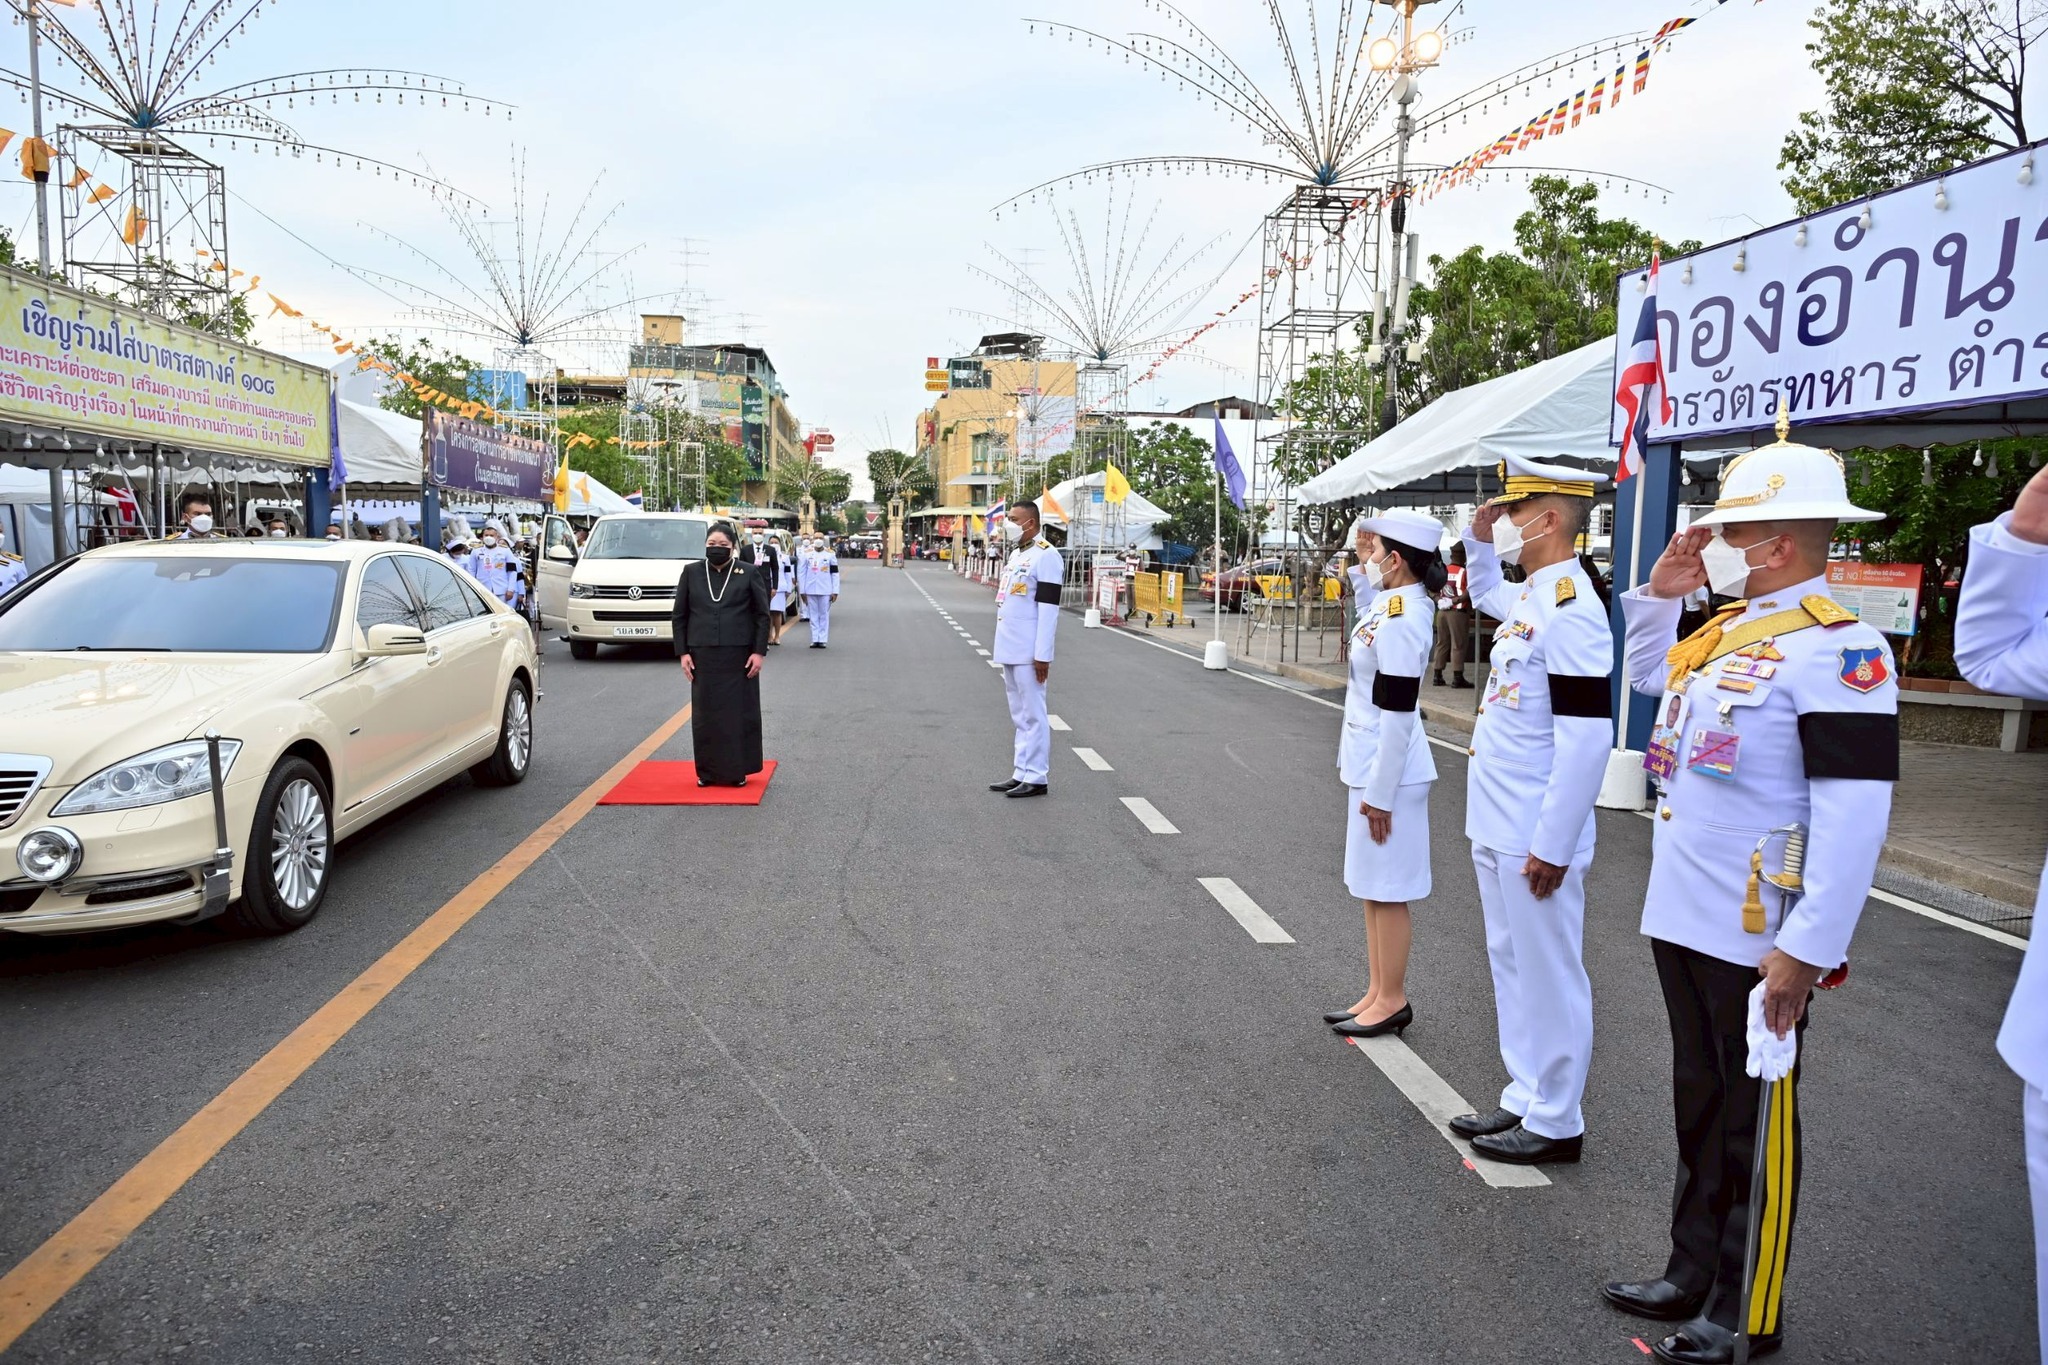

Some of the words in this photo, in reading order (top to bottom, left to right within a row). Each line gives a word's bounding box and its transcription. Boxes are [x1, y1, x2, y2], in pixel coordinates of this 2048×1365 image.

[23, 299, 236, 386] เชิญร่วมใส่บาตรสตางค์
[241, 373, 275, 395] ๑๐๘
[130, 398, 258, 439] ในหน้าที่การงานก้าวหน้า
[283, 424, 305, 448] ขึ้นไป
[131, 374, 211, 406] เสริมดวงบารมี
[215, 393, 317, 428] แก่ตัวท่านและครอบครัว
[635, 627, 654, 635] 9057
